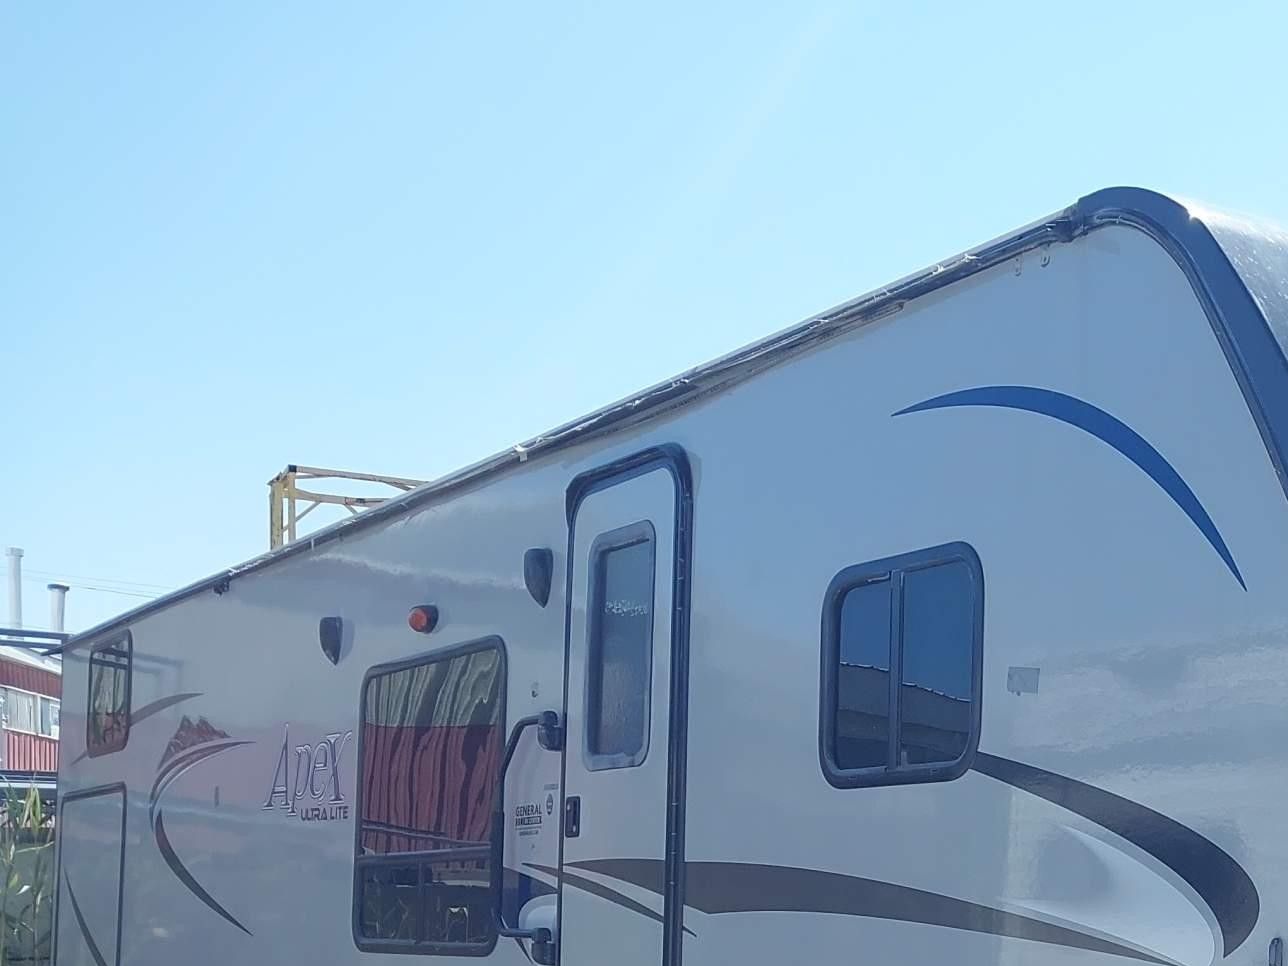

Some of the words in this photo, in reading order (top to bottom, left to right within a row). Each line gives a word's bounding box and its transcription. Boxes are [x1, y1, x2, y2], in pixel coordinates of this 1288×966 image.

[261, 722, 352, 817] Apex
[330, 806, 348, 820] LITE
[515, 804, 542, 817] GENERAL
